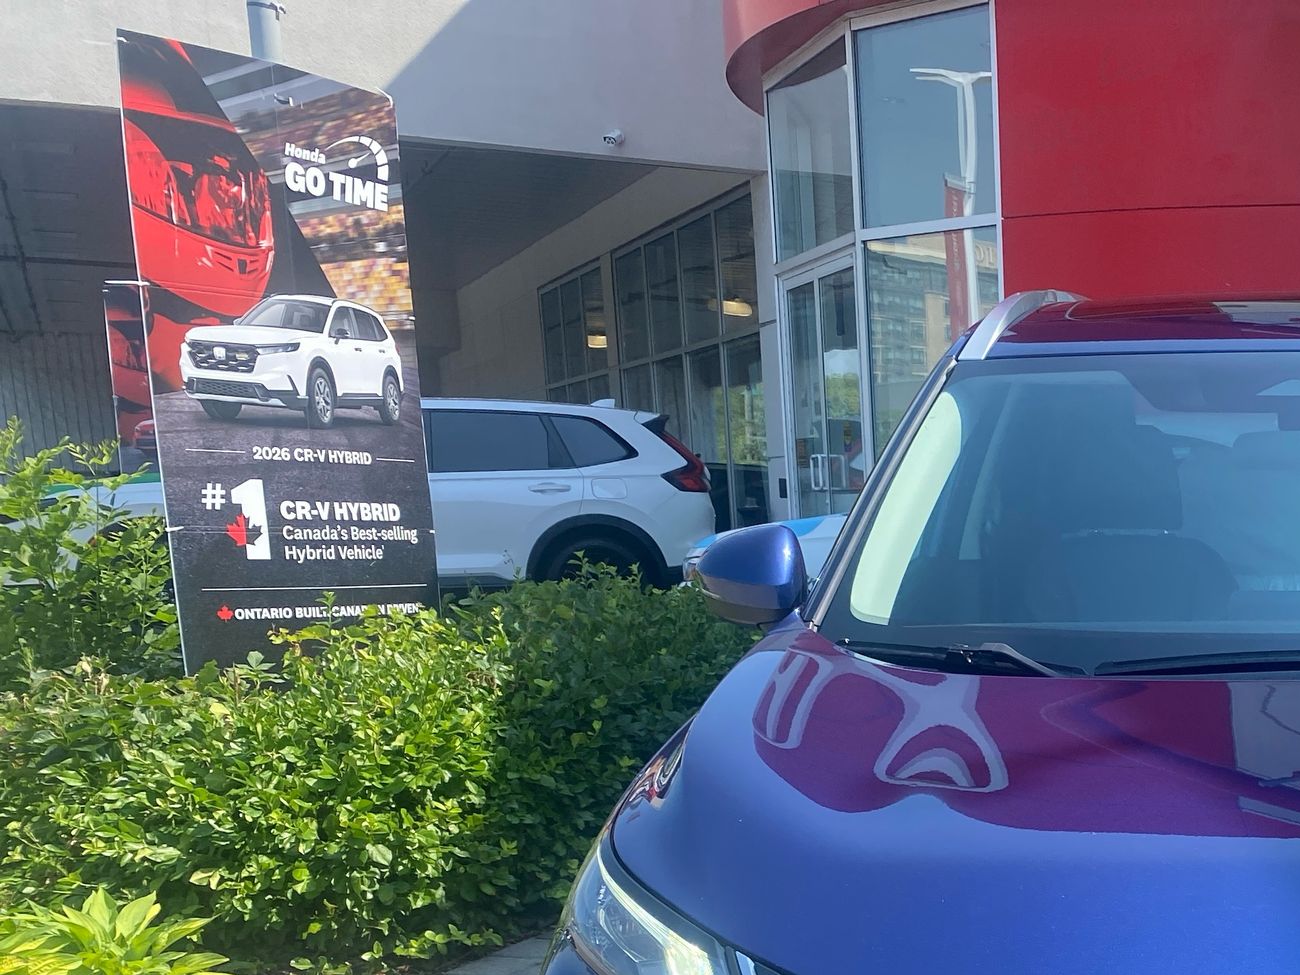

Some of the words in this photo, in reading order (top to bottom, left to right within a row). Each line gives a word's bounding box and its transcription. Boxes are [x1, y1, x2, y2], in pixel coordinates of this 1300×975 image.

[284, 142, 326, 165] Honda
[284, 161, 326, 197] GO
[328, 171, 389, 212] TIME
[252, 446, 291, 461] 2026
[293, 449, 326, 463] CR-V
[328, 450, 372, 465] HYBRID
[280, 500, 331, 521] CR-V
[333, 501, 401, 522] HYBRID
[282, 525, 348, 541] Canada's
[351, 525, 418, 544] Best-selling
[284, 545, 337, 564] Hybrid
[234, 607, 293, 620] ONTARIO
